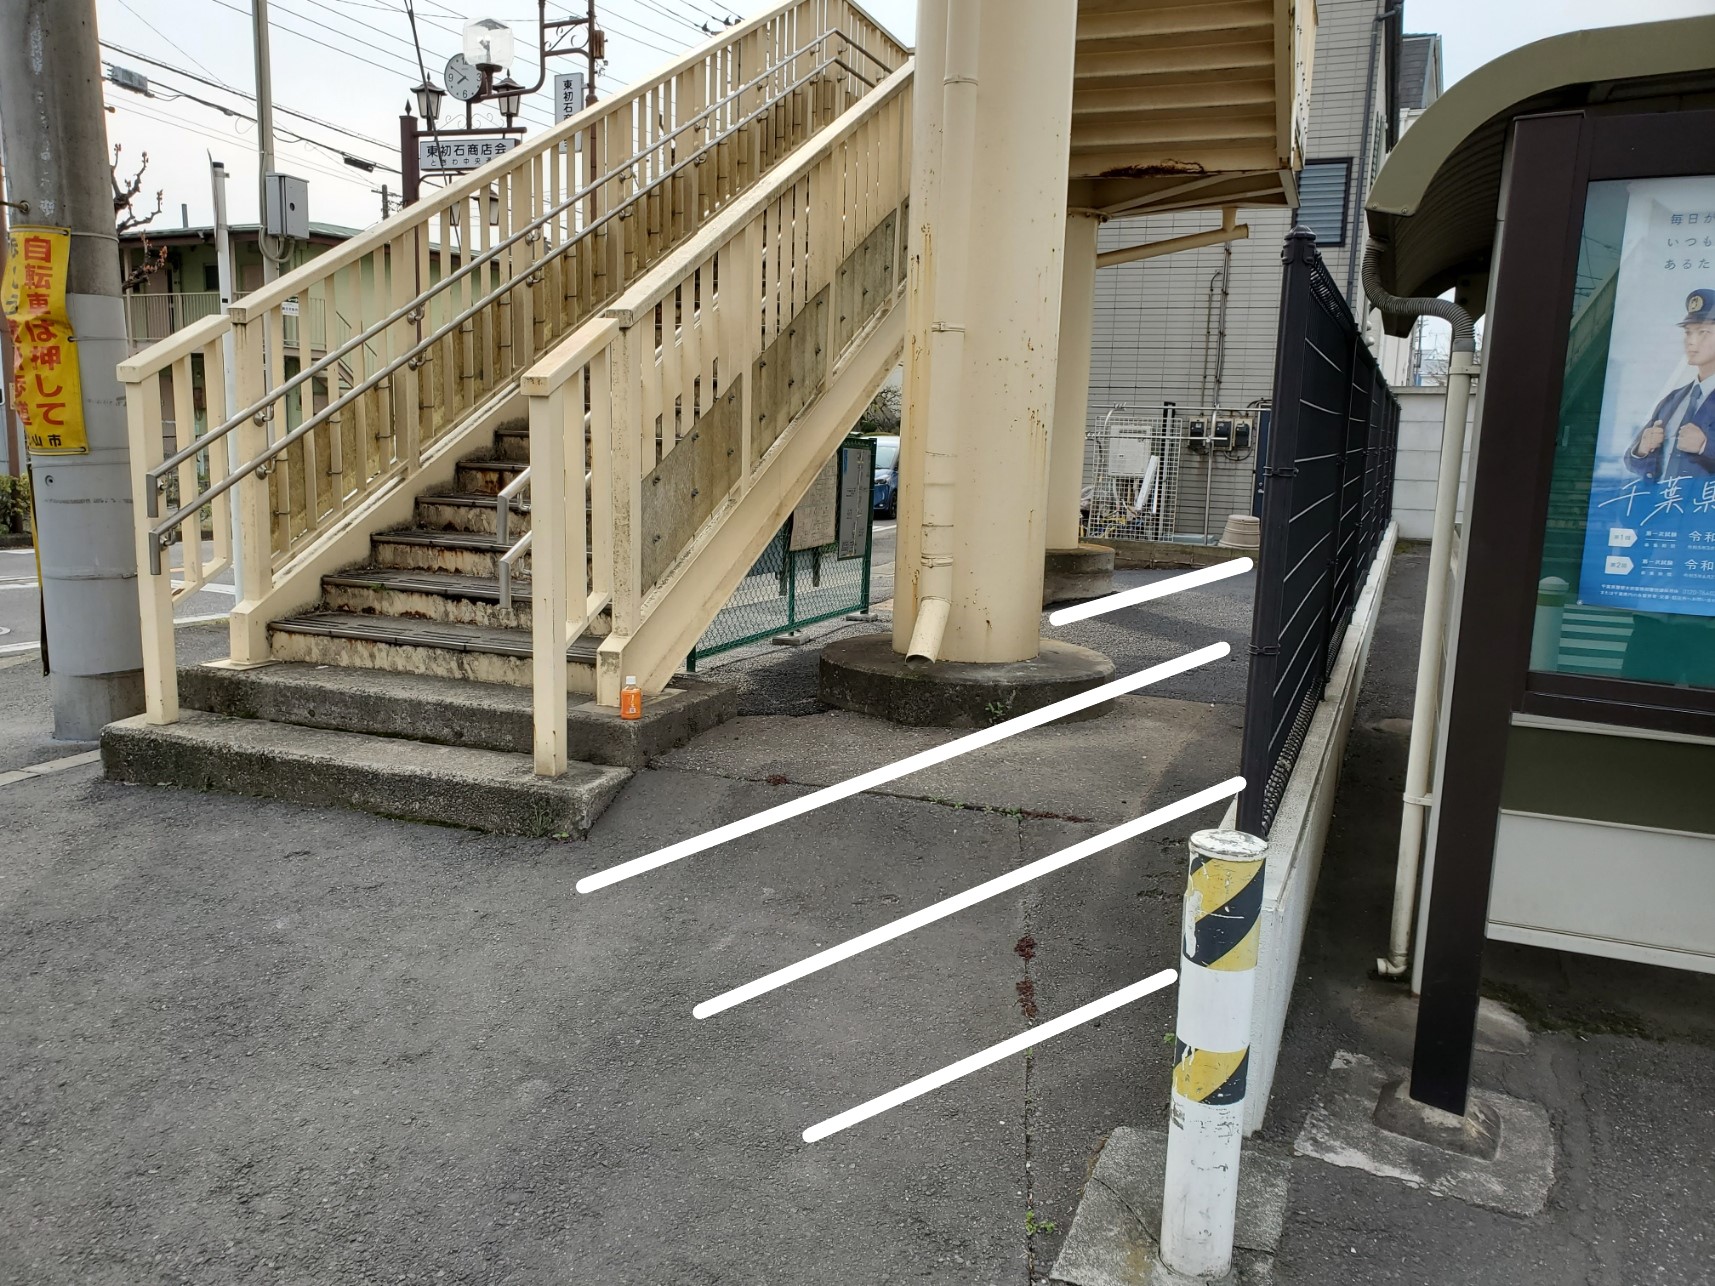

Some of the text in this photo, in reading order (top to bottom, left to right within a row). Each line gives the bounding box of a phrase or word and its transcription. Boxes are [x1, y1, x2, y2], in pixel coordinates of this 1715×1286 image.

[426, 143, 506, 158] 東初石商店会
[24, 235, 66, 426] 自転車は押して
